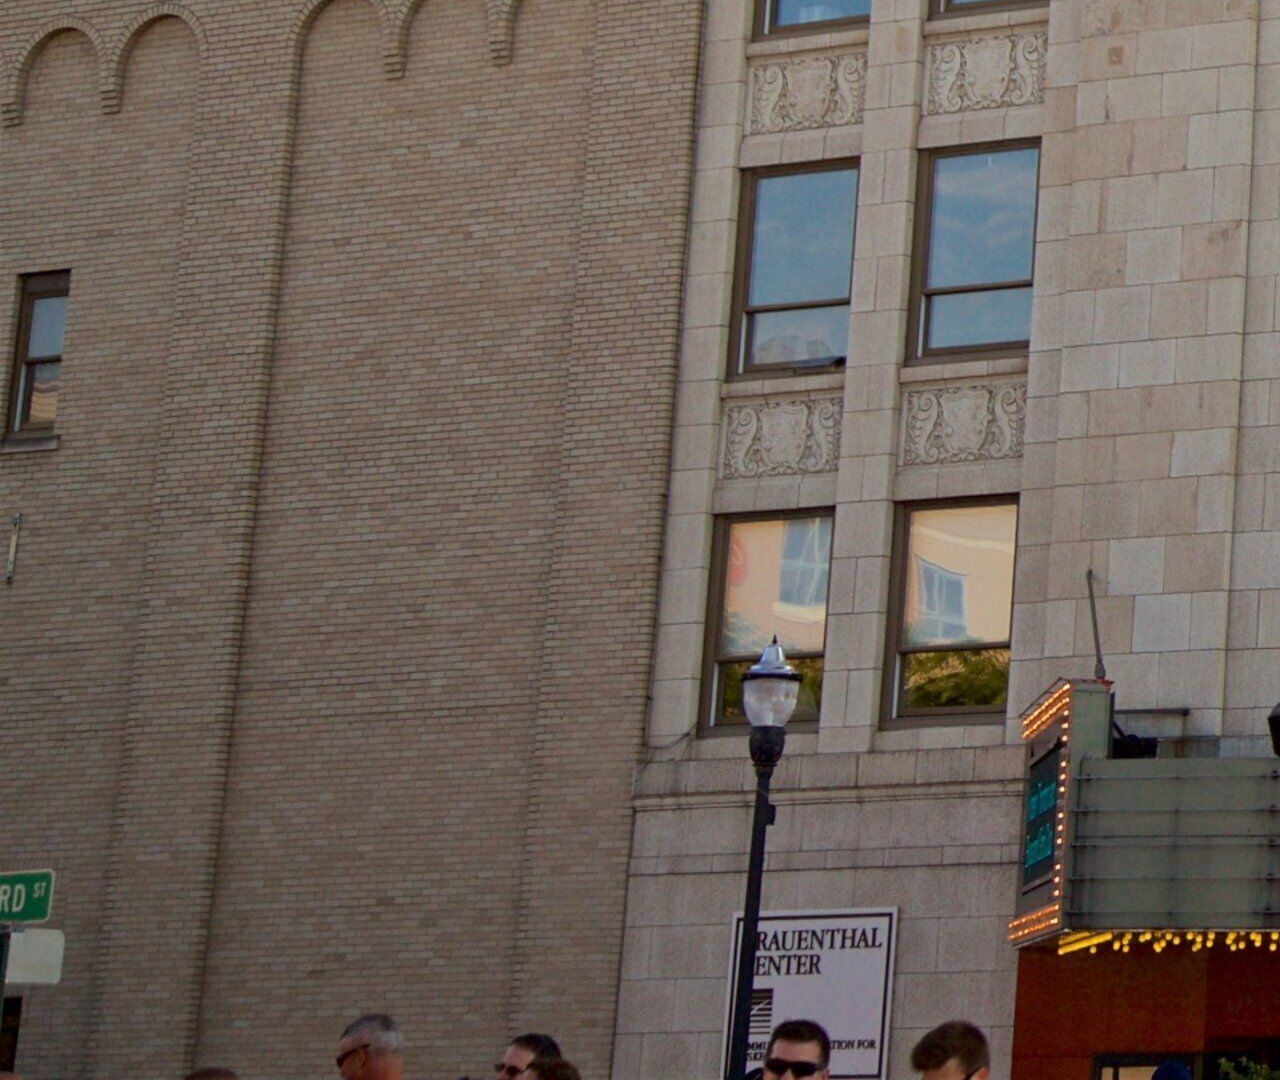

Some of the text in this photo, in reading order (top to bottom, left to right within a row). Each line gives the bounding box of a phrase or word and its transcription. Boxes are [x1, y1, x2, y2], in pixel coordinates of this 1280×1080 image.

[0, 882, 47, 913] RD ST
[756, 928, 882, 951] RAUENTHAL
[754, 954, 822, 976] ENTER
[857, 1040, 876, 1049] FOR
